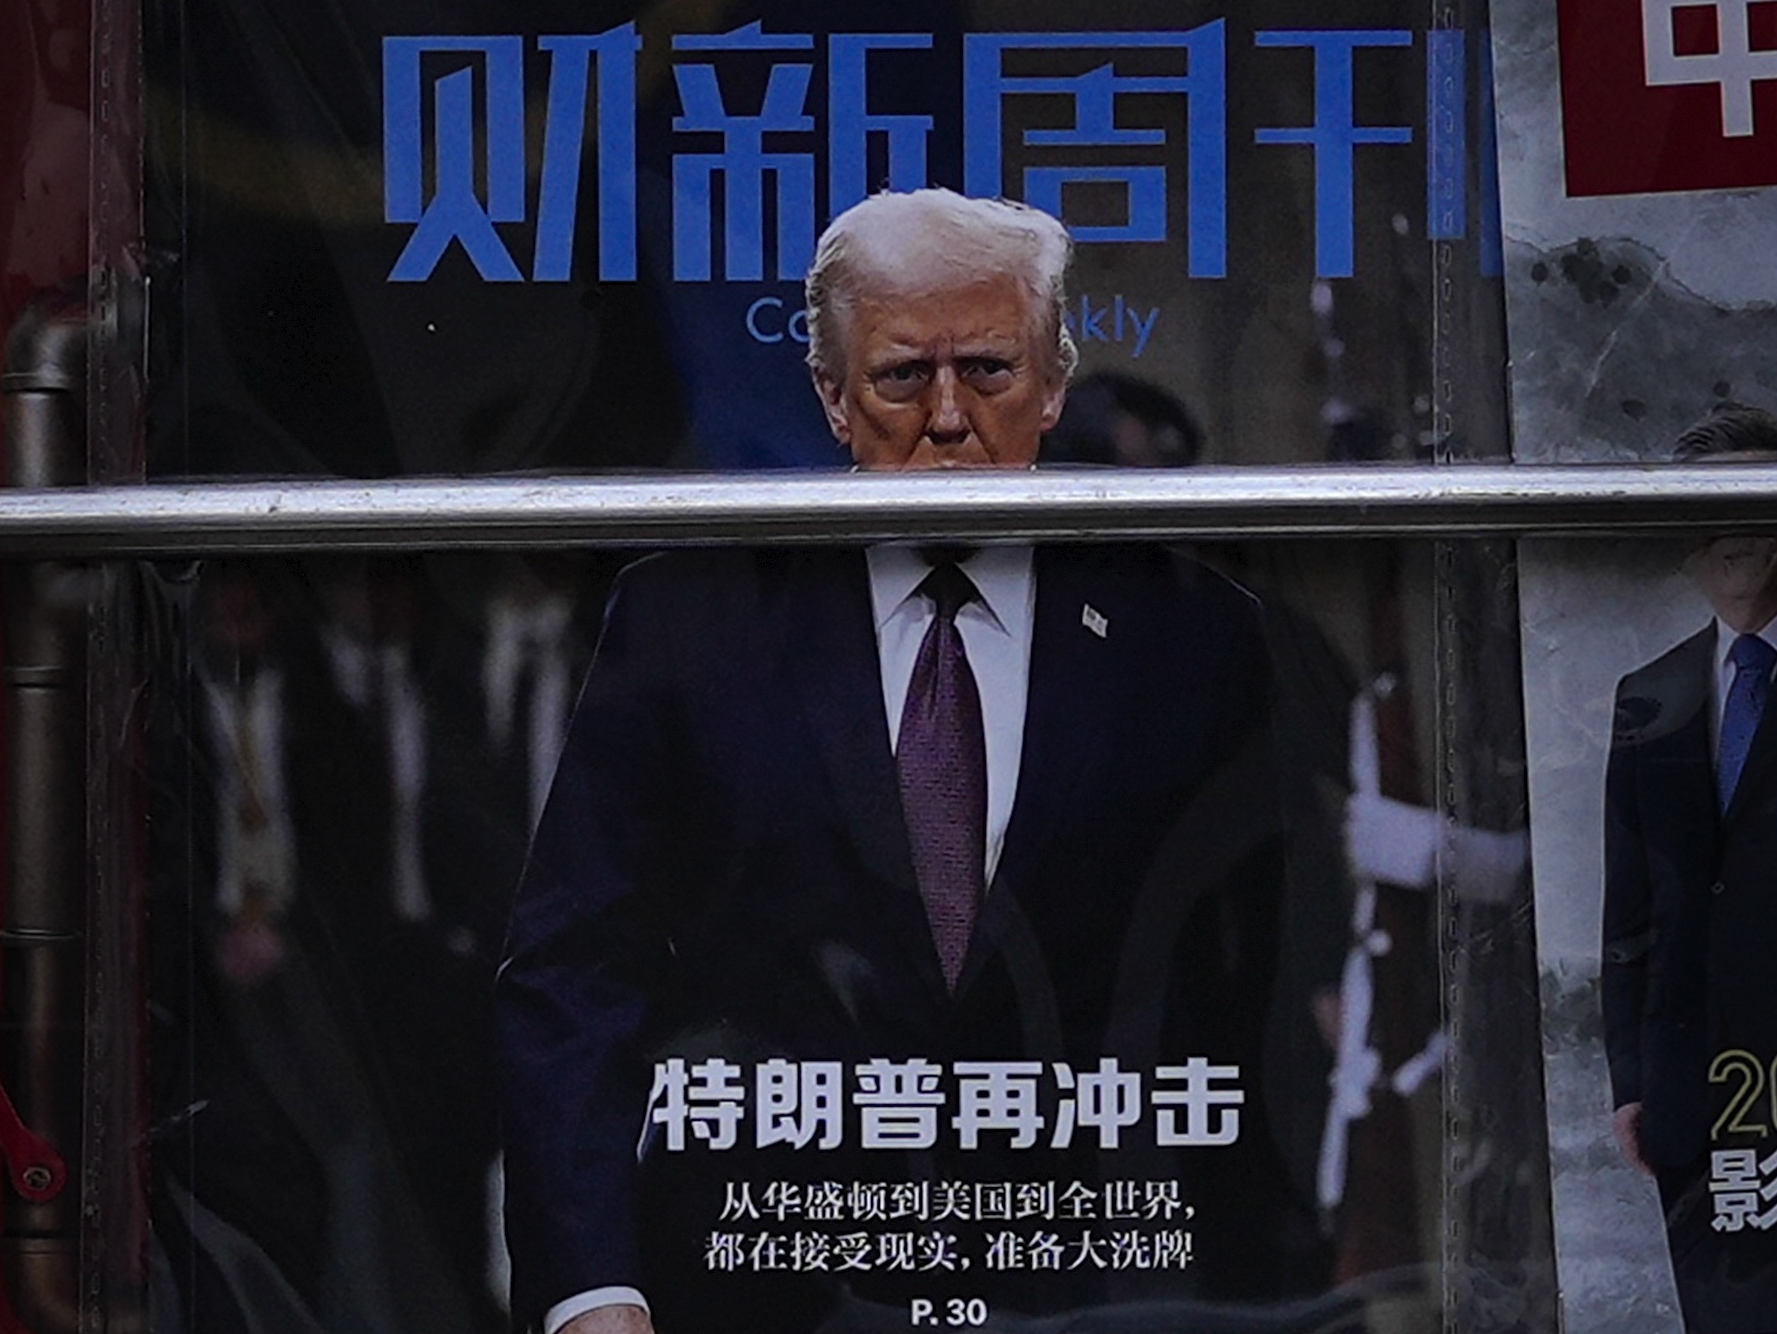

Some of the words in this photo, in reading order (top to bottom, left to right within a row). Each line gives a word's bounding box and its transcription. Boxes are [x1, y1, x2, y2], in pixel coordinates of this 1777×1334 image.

[649, 1056, 1247, 1153] 特朗普再冲击
[703, 1229, 1196, 1273] 都在接受现实，准备大洗牌
